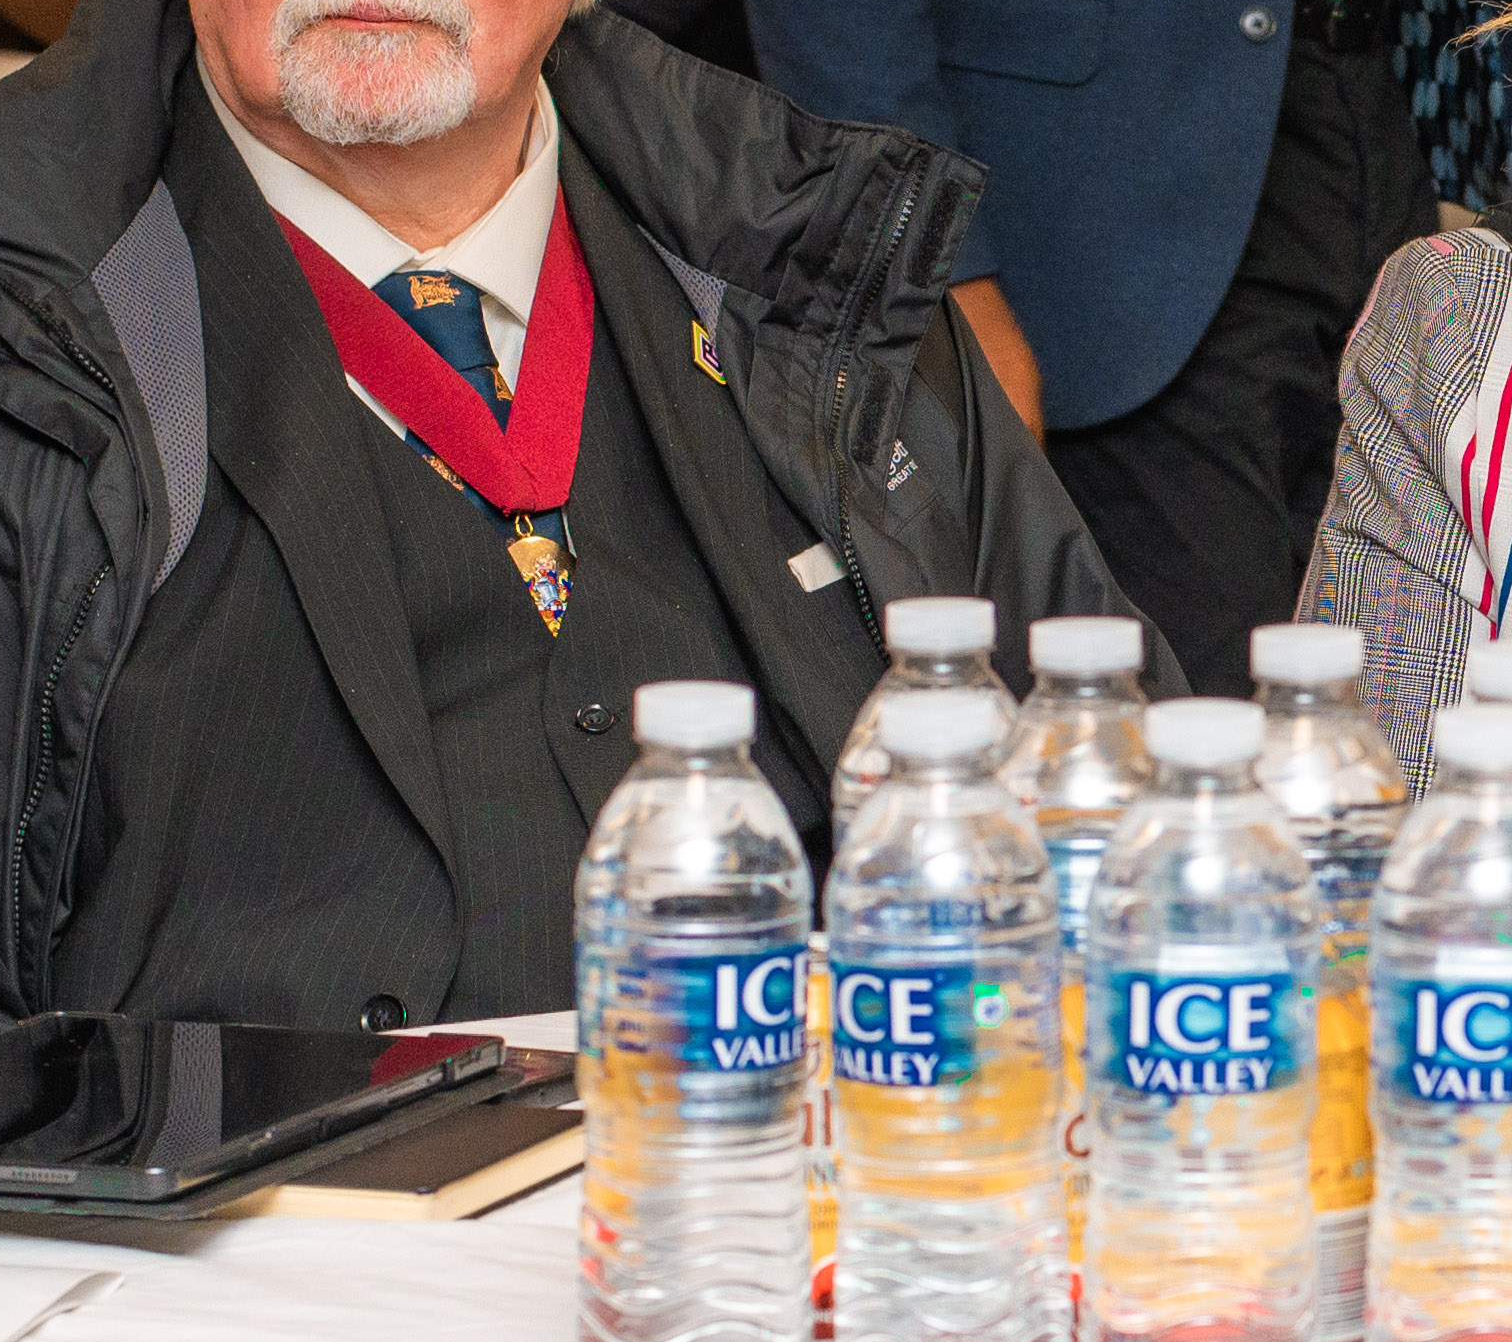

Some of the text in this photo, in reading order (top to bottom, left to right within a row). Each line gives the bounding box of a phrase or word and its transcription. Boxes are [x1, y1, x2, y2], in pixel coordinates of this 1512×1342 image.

[838, 972, 935, 1046] CE
[1129, 980, 1273, 1055] ICE
[1125, 1054, 1274, 1093] VALLEY
